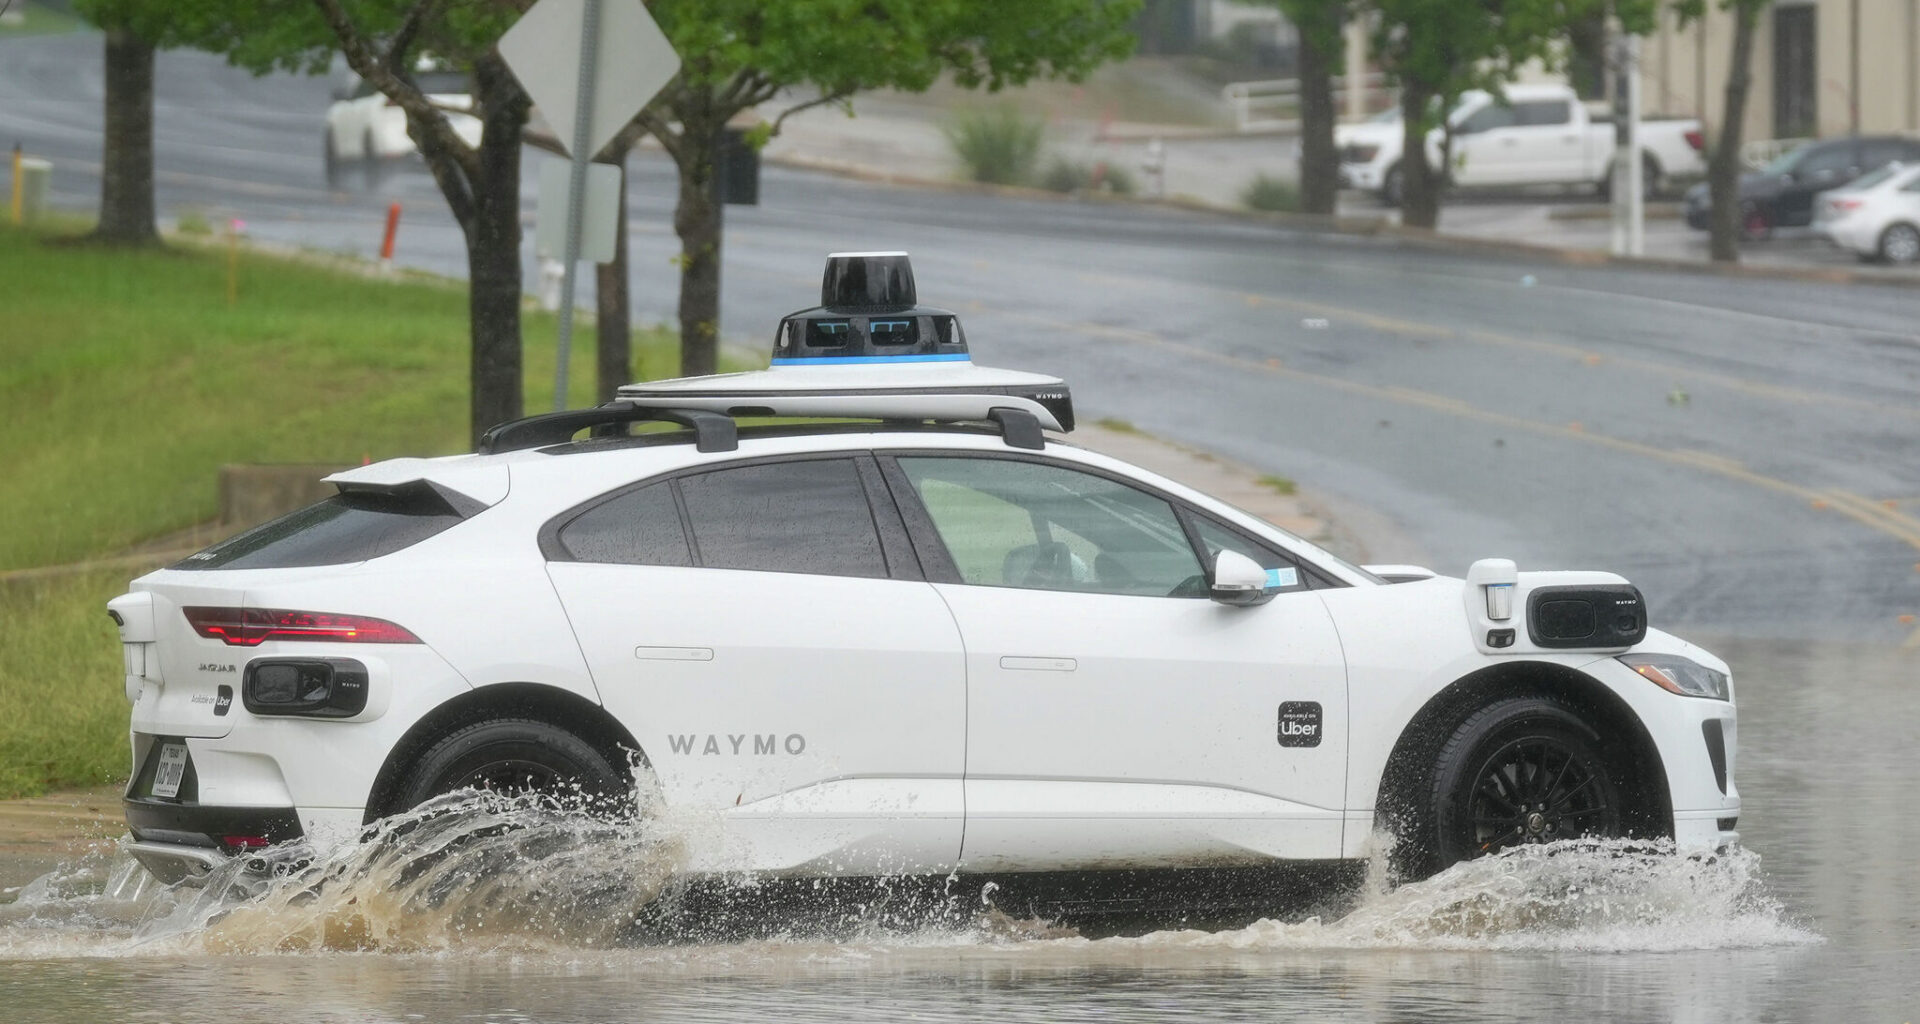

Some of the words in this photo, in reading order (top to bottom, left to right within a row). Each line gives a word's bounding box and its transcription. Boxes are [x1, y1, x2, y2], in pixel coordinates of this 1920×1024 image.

[198, 663, 236, 672] JAGUAR
[216, 696, 231, 706] Uber
[1281, 721, 1318, 735] Uber
[667, 734, 806, 756] WAYMO
